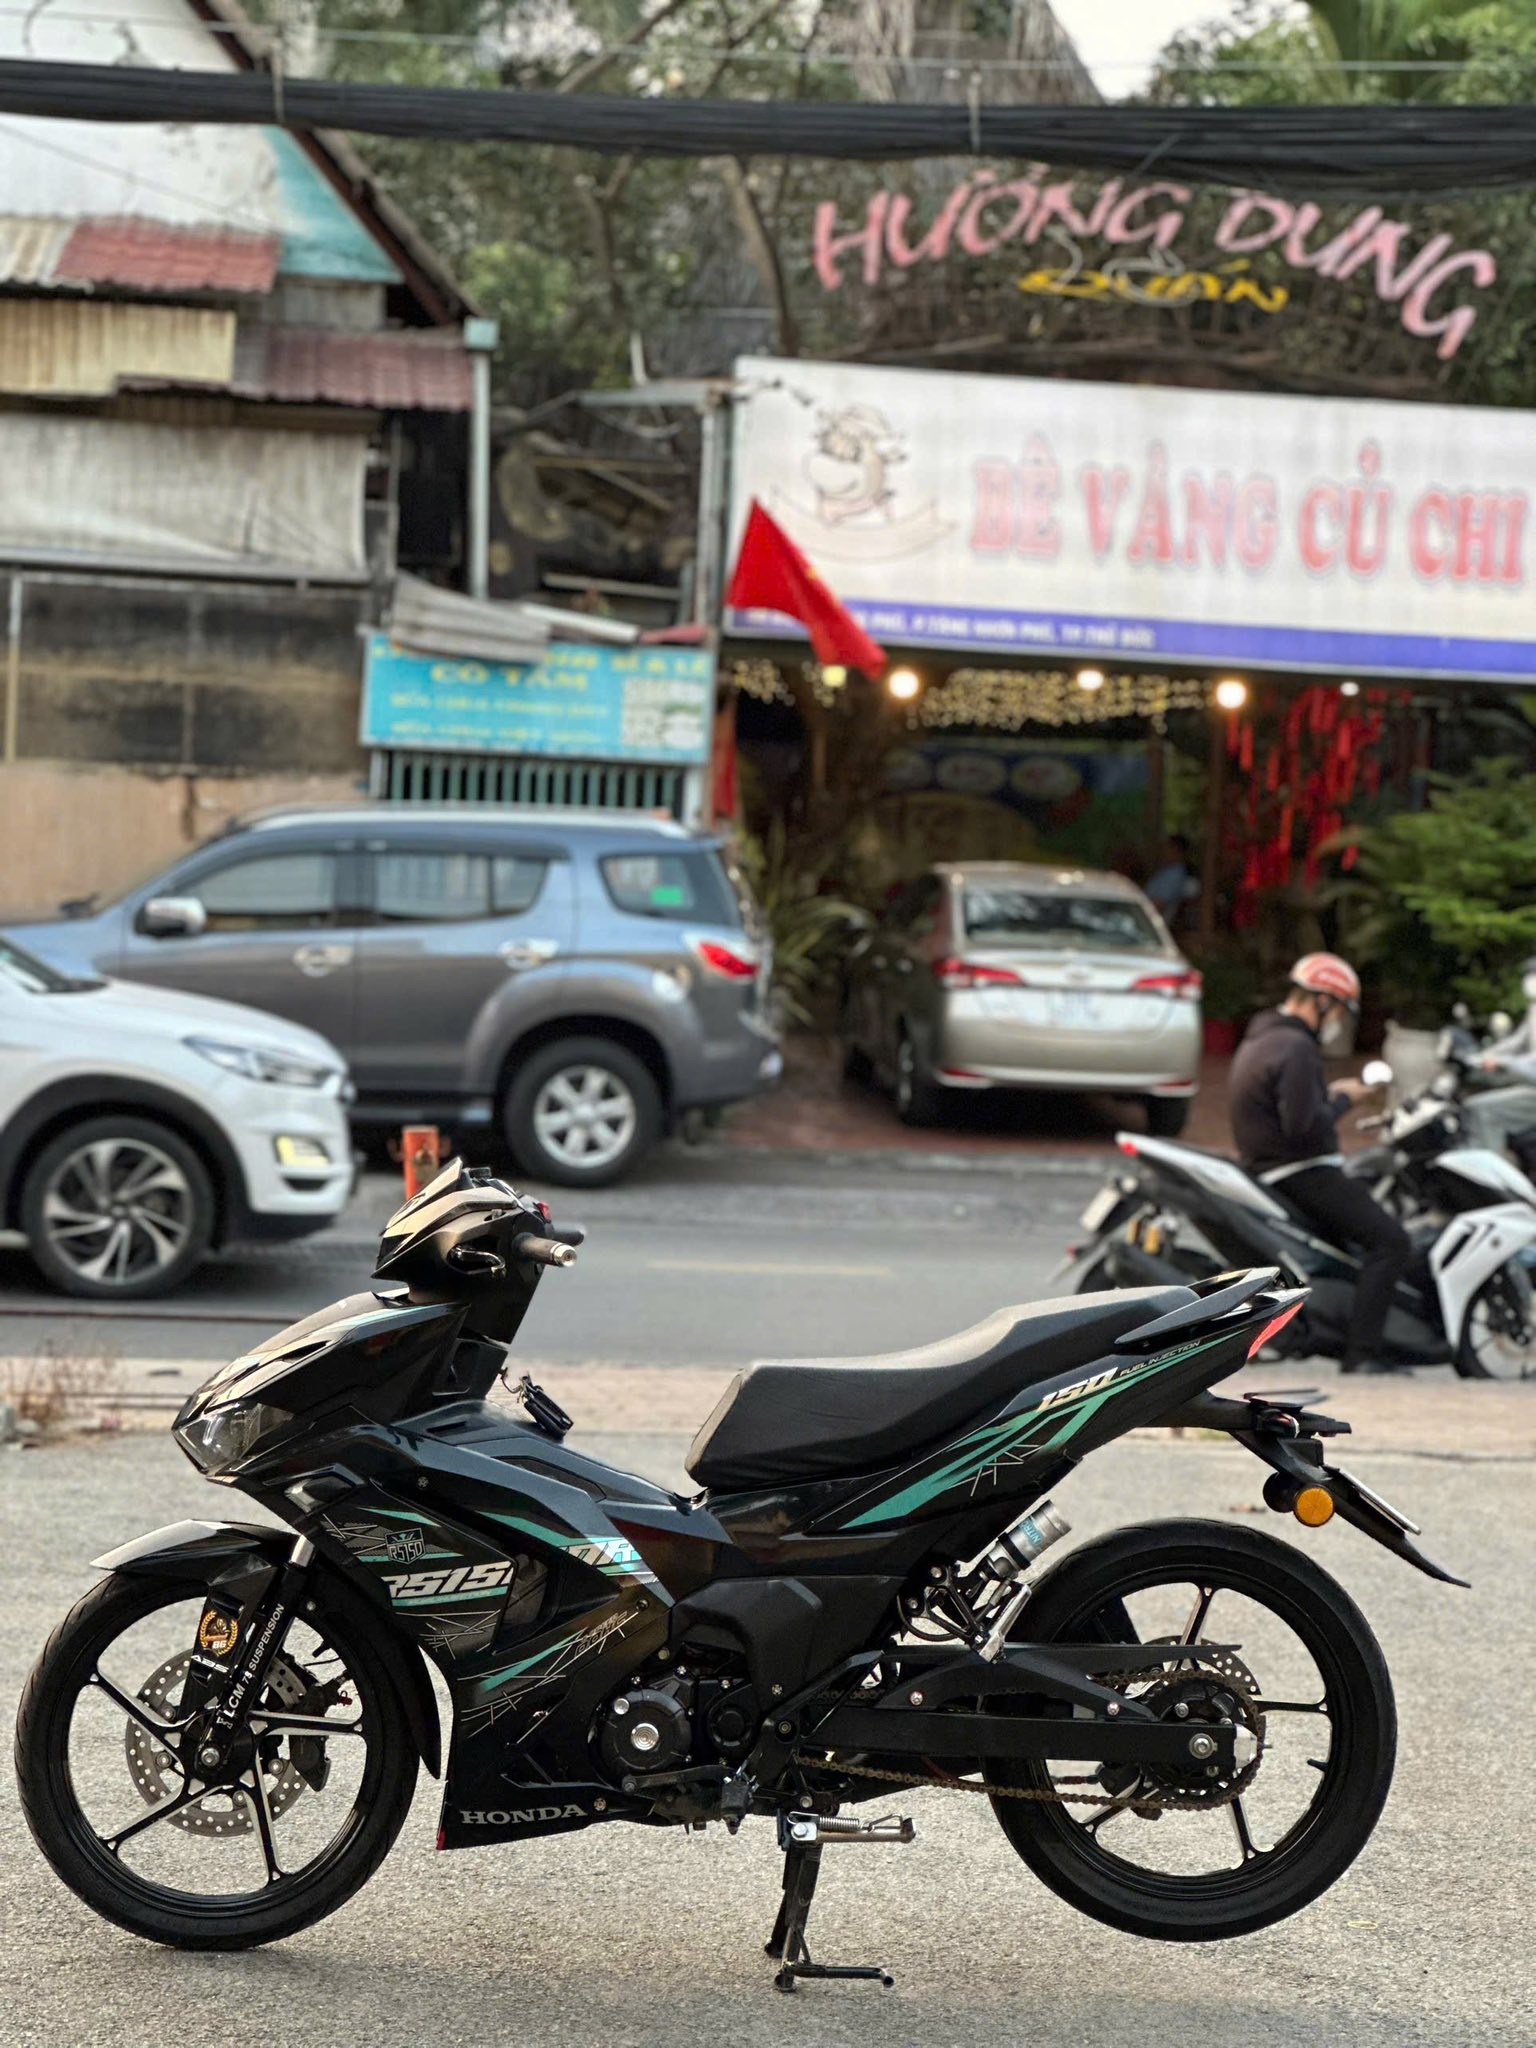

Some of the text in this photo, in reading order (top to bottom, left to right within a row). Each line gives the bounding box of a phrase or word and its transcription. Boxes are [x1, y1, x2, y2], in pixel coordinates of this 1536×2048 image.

[1408, 486, 1529, 586] CHI
[1036, 1341, 1201, 1413] 150 FUEL INJECTION
[388, 1541, 422, 1562] RS150
[381, 1560, 514, 1598] RS15
[191, 1654, 229, 1673] ABS
[223, 1683, 247, 1718] LCM
[249, 1603, 285, 1671] SUSPENSION
[460, 1804, 588, 1825] HONDA
